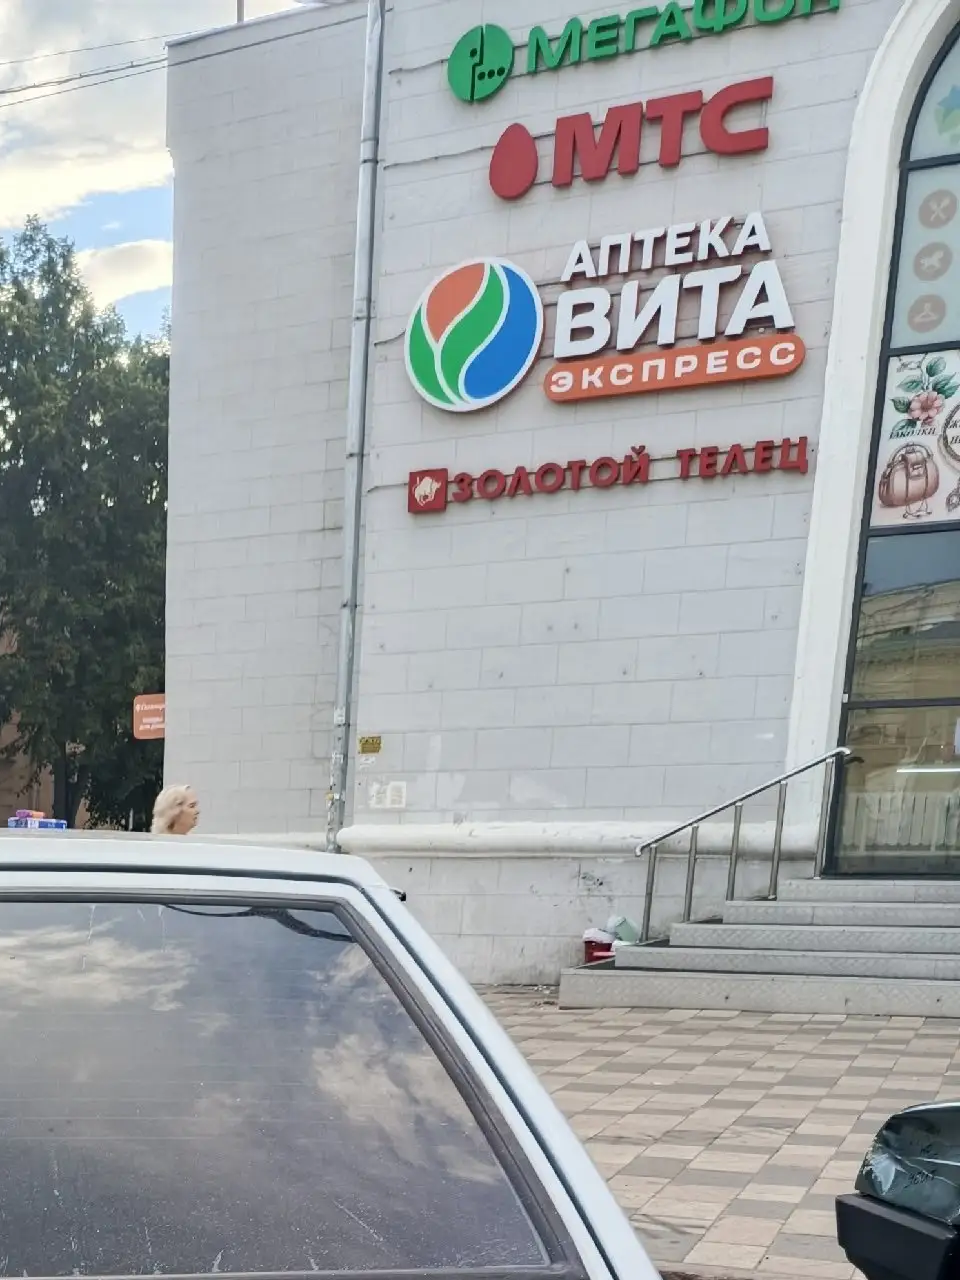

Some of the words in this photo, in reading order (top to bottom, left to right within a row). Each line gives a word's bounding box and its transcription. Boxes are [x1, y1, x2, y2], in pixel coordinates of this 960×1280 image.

[526, 0, 839, 74] МЕГАФО
[552, 76, 773, 188] МТС
[560, 211, 772, 282] АПТЕКА
[554, 259, 795, 359] ВИТА
[550, 342, 796, 393] ЭКСПРЕСС
[452, 445, 651, 500] ЗОЛОТОЙ
[676, 436, 808, 480] ТЕЛЕЦ
